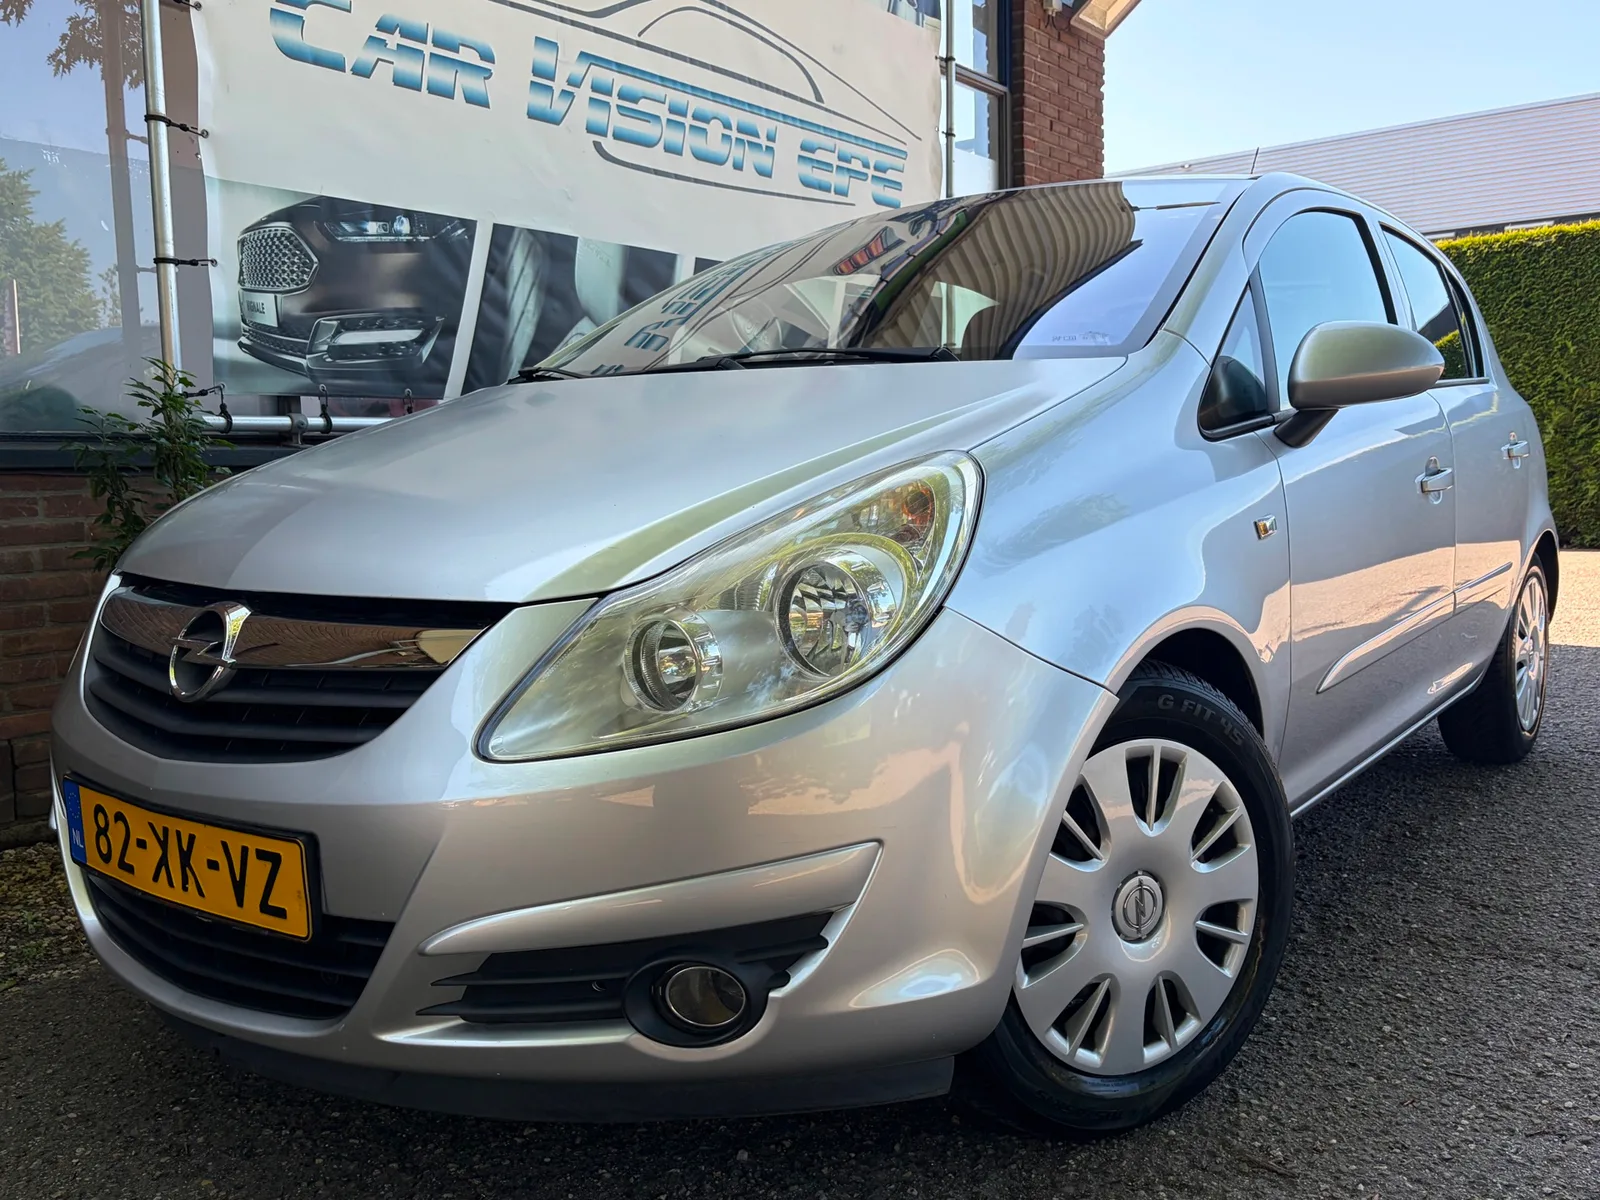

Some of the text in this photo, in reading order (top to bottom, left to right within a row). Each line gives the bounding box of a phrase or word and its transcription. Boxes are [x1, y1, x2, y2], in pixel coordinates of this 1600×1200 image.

[270, 0, 905, 209] CAR VISION EPE
[1157, 693, 1175, 710] G
[1181, 698, 1216, 721] FIT
[71, 827, 84, 848] NL
[93, 803, 288, 920] 82-XK-VZ
